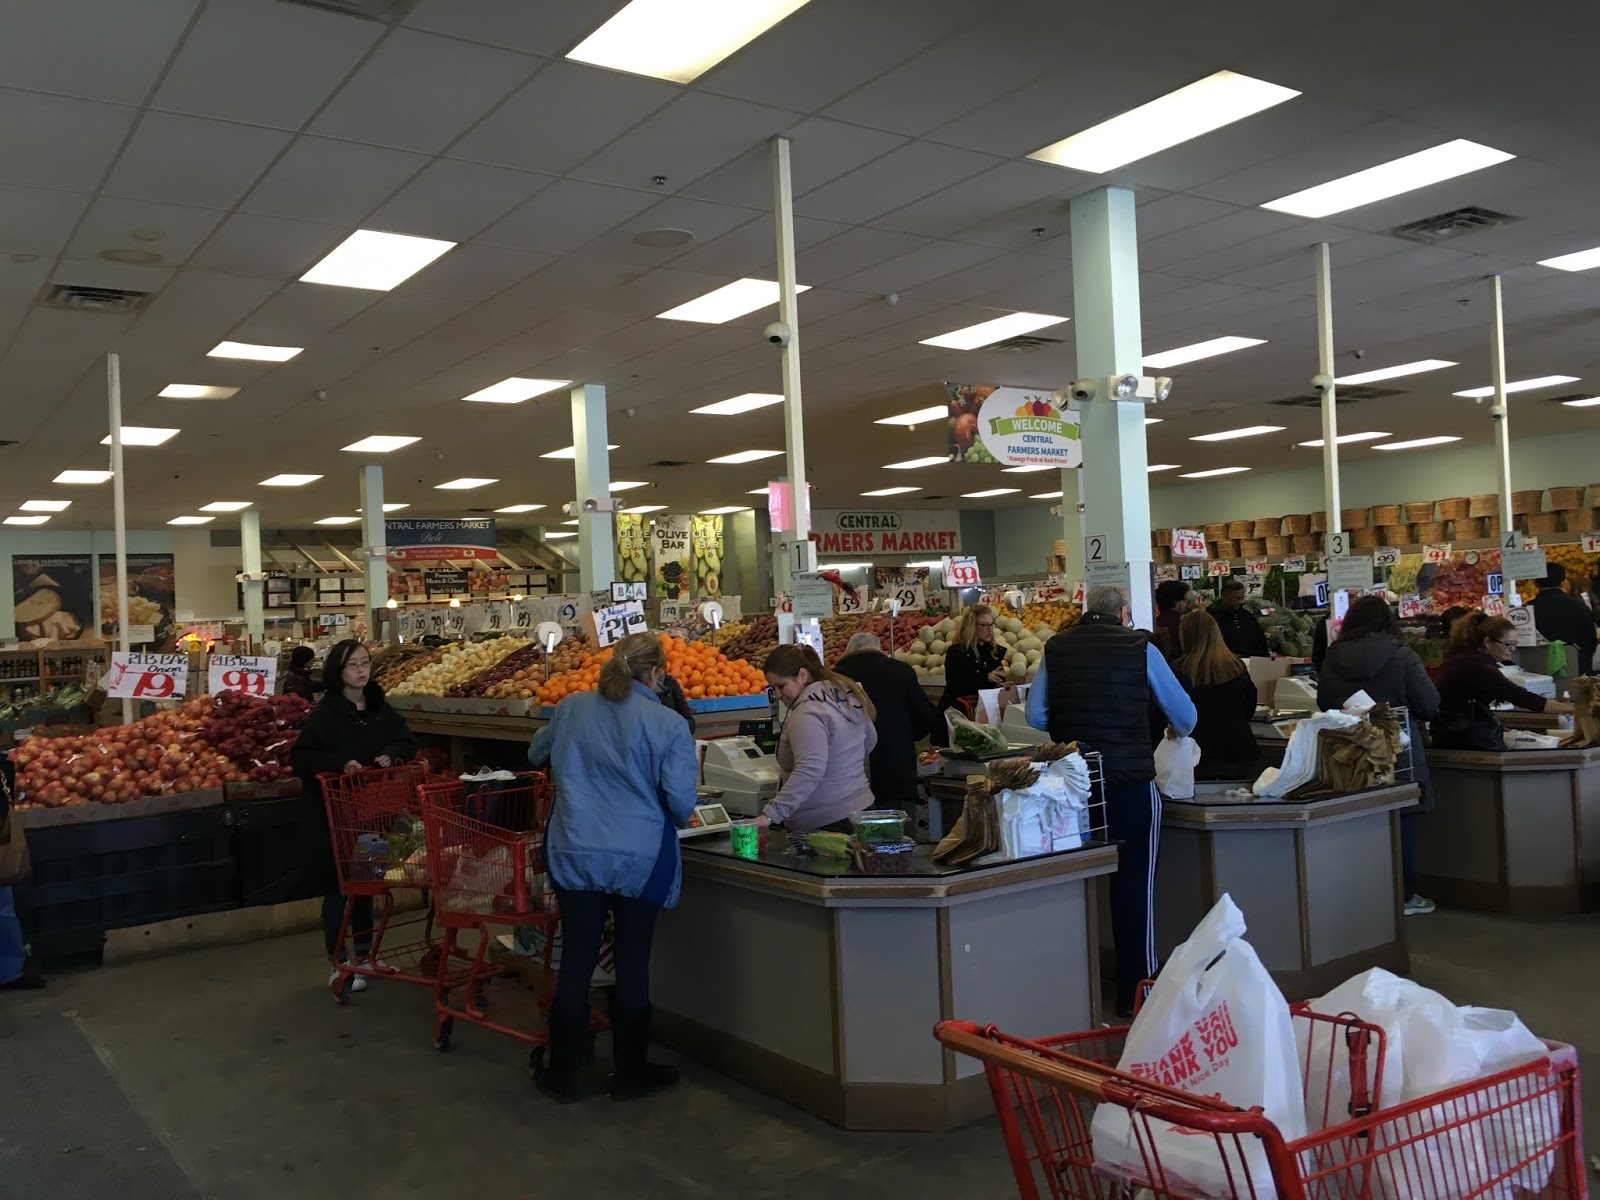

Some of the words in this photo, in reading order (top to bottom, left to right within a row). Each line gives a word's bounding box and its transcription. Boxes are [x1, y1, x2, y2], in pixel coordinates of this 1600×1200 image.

[1012, 419, 1062, 433] WELCOME
[1022, 434, 1053, 444] CENTRAL
[1007, 445, 1039, 455] FARMERS
[1041, 448, 1068, 456] MARKET
[385, 522, 414, 530] NTRAL
[456, 521, 490, 529] MARKET
[840, 515, 897, 528] CENTRAL
[420, 531, 442, 543] Deli
[619, 530, 651, 538] OLIVE
[656, 529, 688, 539] OLIVE
[693, 530, 723, 538] OLIVE
[625, 541, 646, 549] BAR
[662, 540, 684, 549] BAR
[698, 541, 719, 549] BAR
[808, 531, 874, 552] RMERS
[882, 531, 956, 551] MARKET
[1332, 535, 1343, 554] 3
[1505, 534, 1517, 549] 4
[1090, 538, 1102, 560] 2
[795, 544, 801, 570] 1
[953, 567, 977, 584] 99
[1490, 575, 1503, 592] OP
[617, 585, 644, 598] B4A
[843, 597, 860, 612] 59
[160, 654, 187, 665] BAG
[239, 657, 258, 666] Red
[222, 670, 265, 695] 99
[1203, 1026, 1238, 1064] YOU
[1190, 1071, 1210, 1087] Nice
[1211, 1057, 1229, 1073] Day
